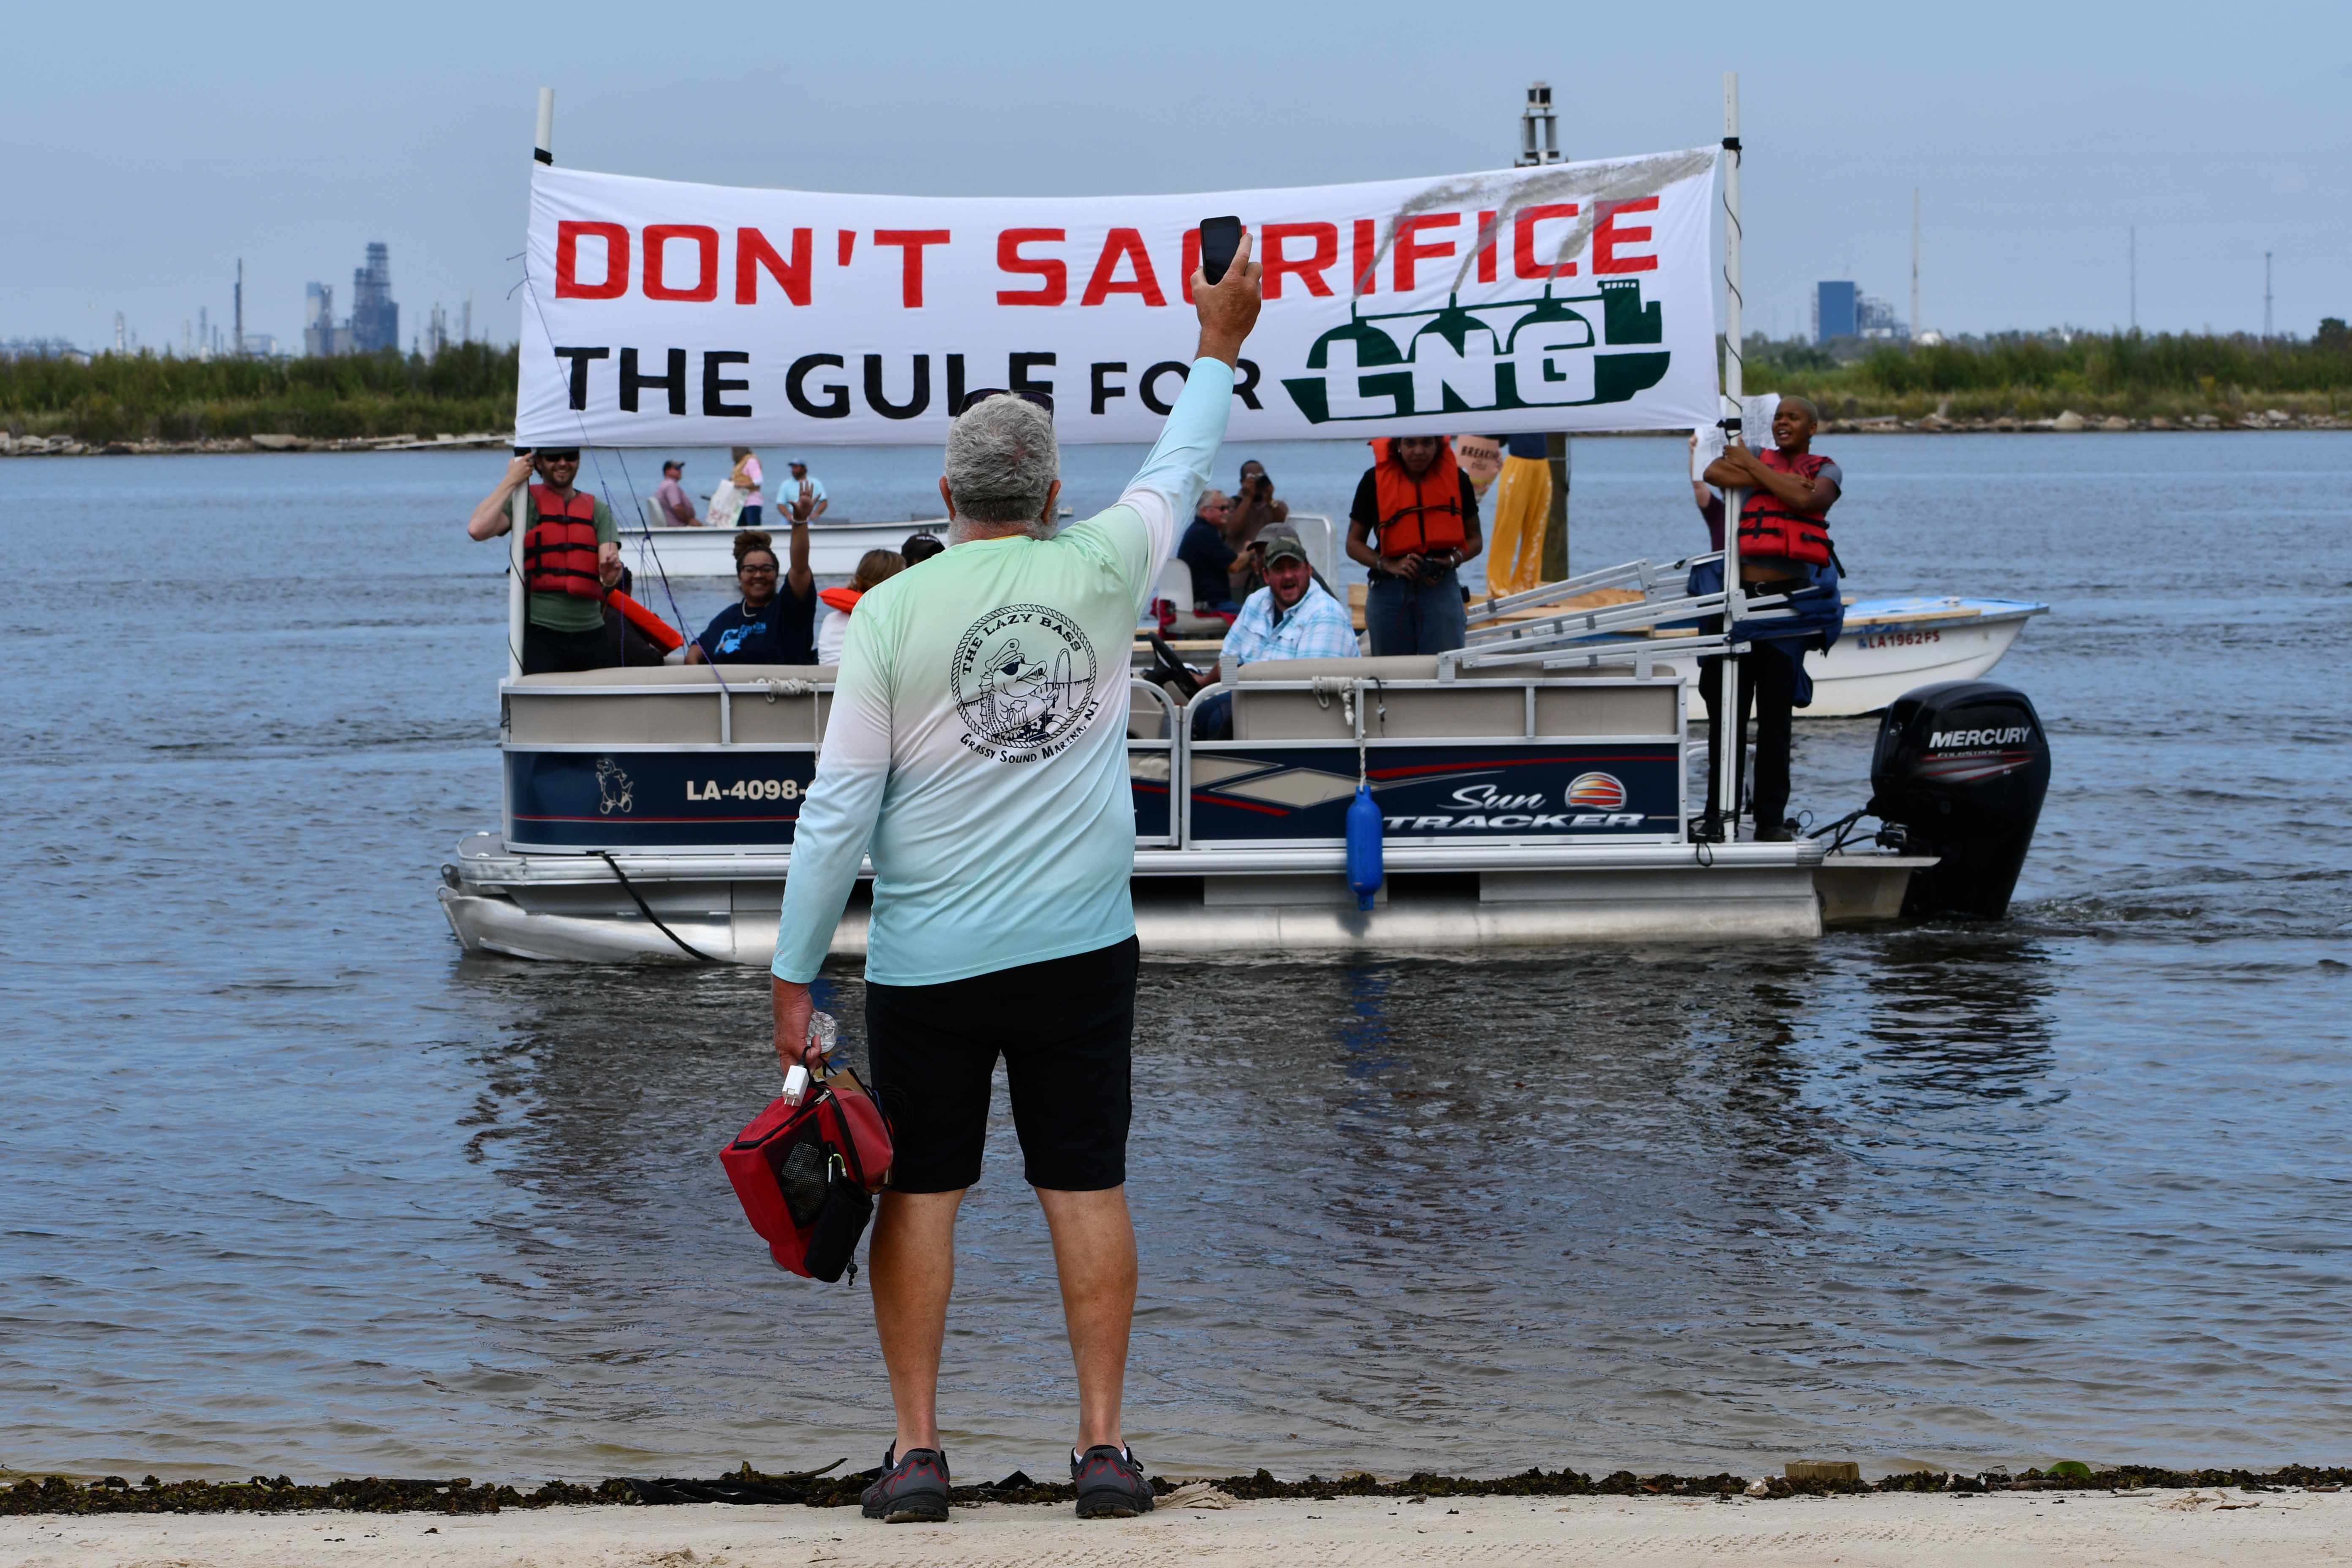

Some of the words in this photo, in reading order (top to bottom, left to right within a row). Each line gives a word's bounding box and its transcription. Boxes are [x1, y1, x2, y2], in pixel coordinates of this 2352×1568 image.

[555, 220, 950, 308] DON'T
[554, 347, 752, 417] THE
[785, 352, 1056, 420] GULF
[1091, 358, 1264, 416] FOR
[1326, 320, 1596, 419] LNG
[962, 637, 983, 675] THE
[983, 614, 1032, 636] LAZY
[1040, 616, 1082, 652] BASS
[999, 750, 1037, 763] SOUND
[1084, 698, 1099, 721] NJ
[1929, 727, 2030, 748] MERCURY
[687, 779, 814, 800] LA-4098-
[1437, 784, 1546, 810] Sun
[1383, 813, 1645, 830] TRACKER
